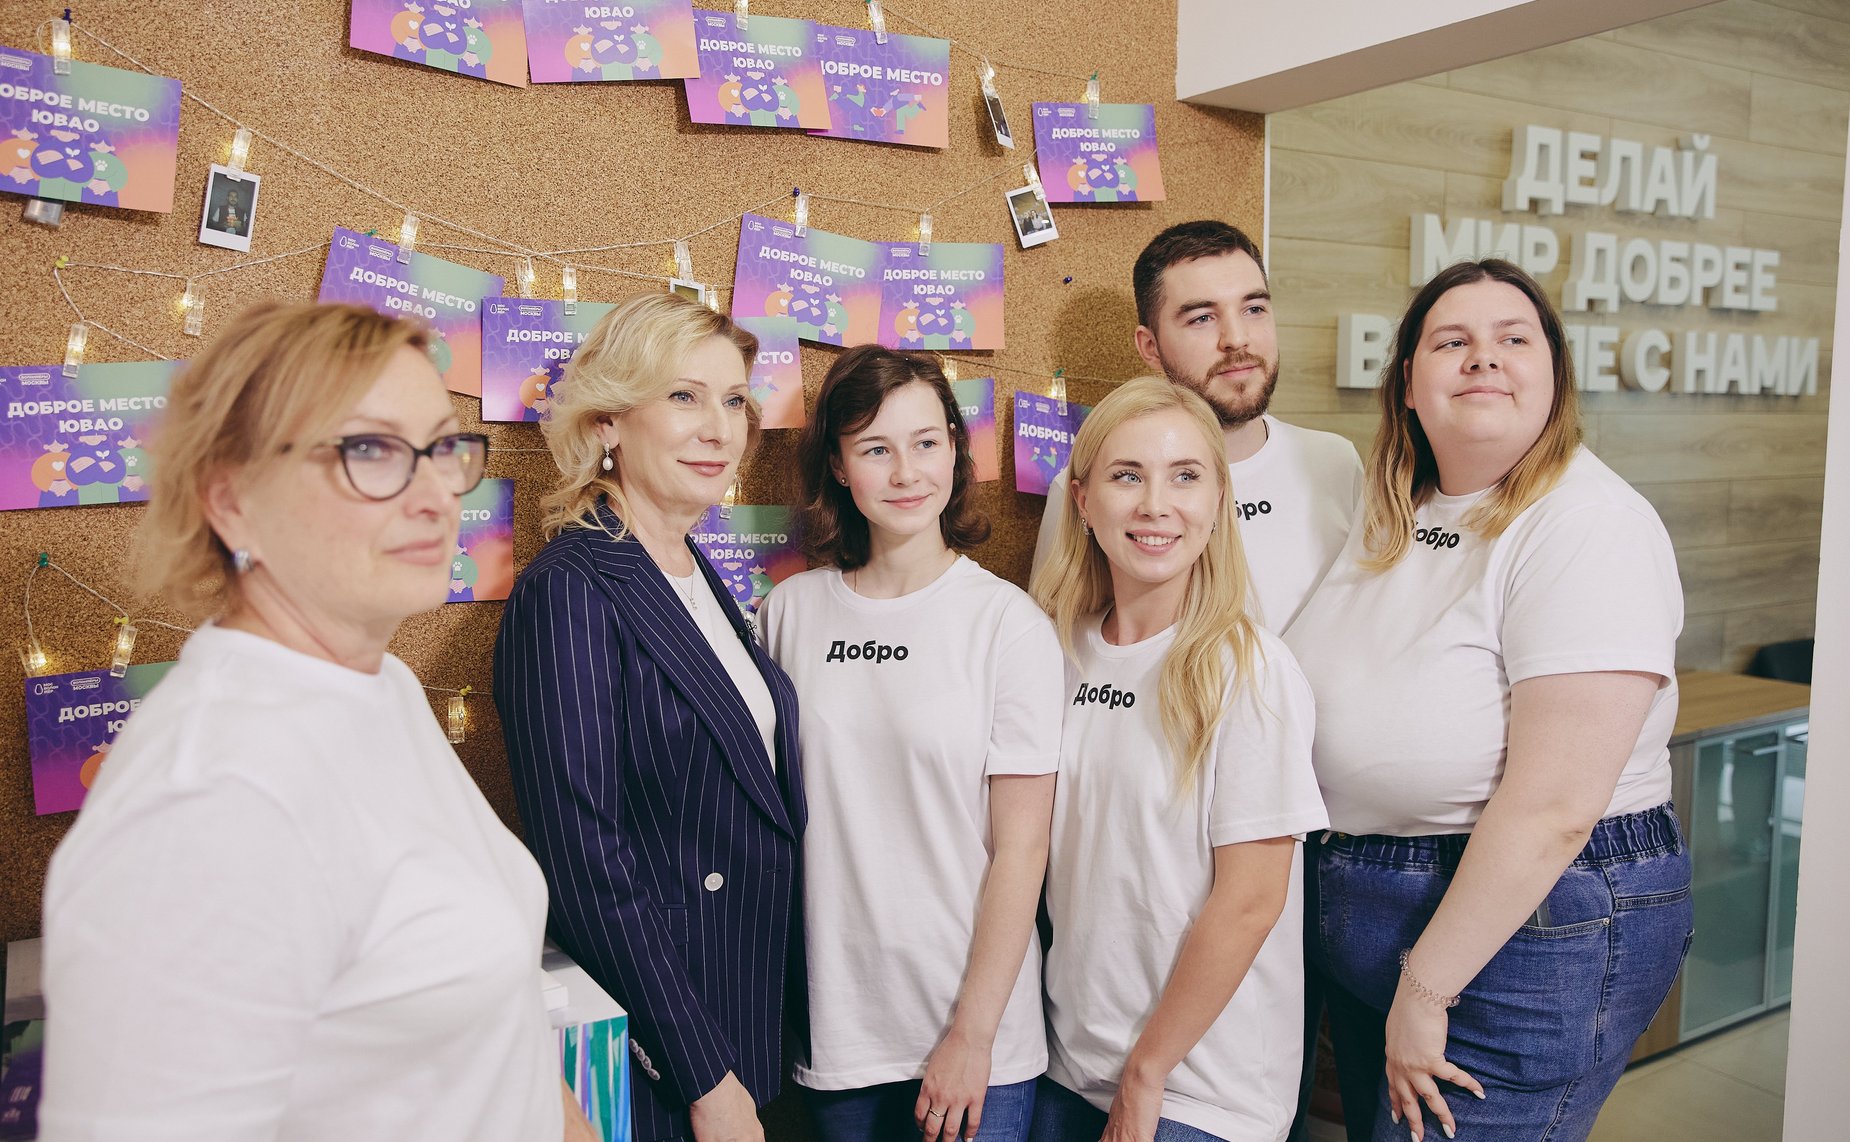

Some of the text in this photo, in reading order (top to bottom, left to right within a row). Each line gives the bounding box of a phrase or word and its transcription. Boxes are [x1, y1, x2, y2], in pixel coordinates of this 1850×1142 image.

[584, 6, 634, 18] ЮВАО
[700, 38, 803, 57] ДОБРОЕ МЕСТО
[733, 57, 775, 70] ЮВАО
[886, 67, 943, 86] МЕСТО
[0, 83, 150, 122] ОБРОЕ МЕСТО
[31, 109, 100, 133] ЮВАО
[1051, 128, 1140, 139] ДОБРОЕ МЕСТО
[1080, 142, 1116, 152] ЮВАО
[1503, 124, 1717, 220] ДЕЛАЙ
[759, 245, 866, 279] ДОБРОЕ МЕСТО
[1410, 212, 1781, 313] МИР ДОБРЕЕ
[790, 268, 833, 287] ЮВАО
[883, 268, 986, 281] ДОБРОЕ МЕСТО
[349, 266, 476, 313] ДОБРОЕ МЕСТО
[913, 284, 955, 295] ЮВАО
[385, 295, 437, 319] ЮВАО
[506, 329, 573, 344] ДОБРОЕ
[544, 347, 577, 360] ЮВ
[756, 351, 794, 365] СТО
[1621, 329, 1671, 392] С
[1670, 330, 1820, 396] НАМИ
[7, 396, 168, 419] ДОБРОЕ МЕСТО
[58, 417, 124, 434] ЮВАО
[1018, 422, 1069, 445] ДОБРОЕ
[460, 509, 491, 521] СТО
[690, 533, 788, 544] ОБРОЕ МЕСТО
[1412, 526, 1460, 550] обро
[710, 549, 755, 560] ЮВАО
[826, 640, 909, 664] Добро
[1073, 682, 1136, 710] Добро
[58, 698, 141, 723] ДОБРОЕ
